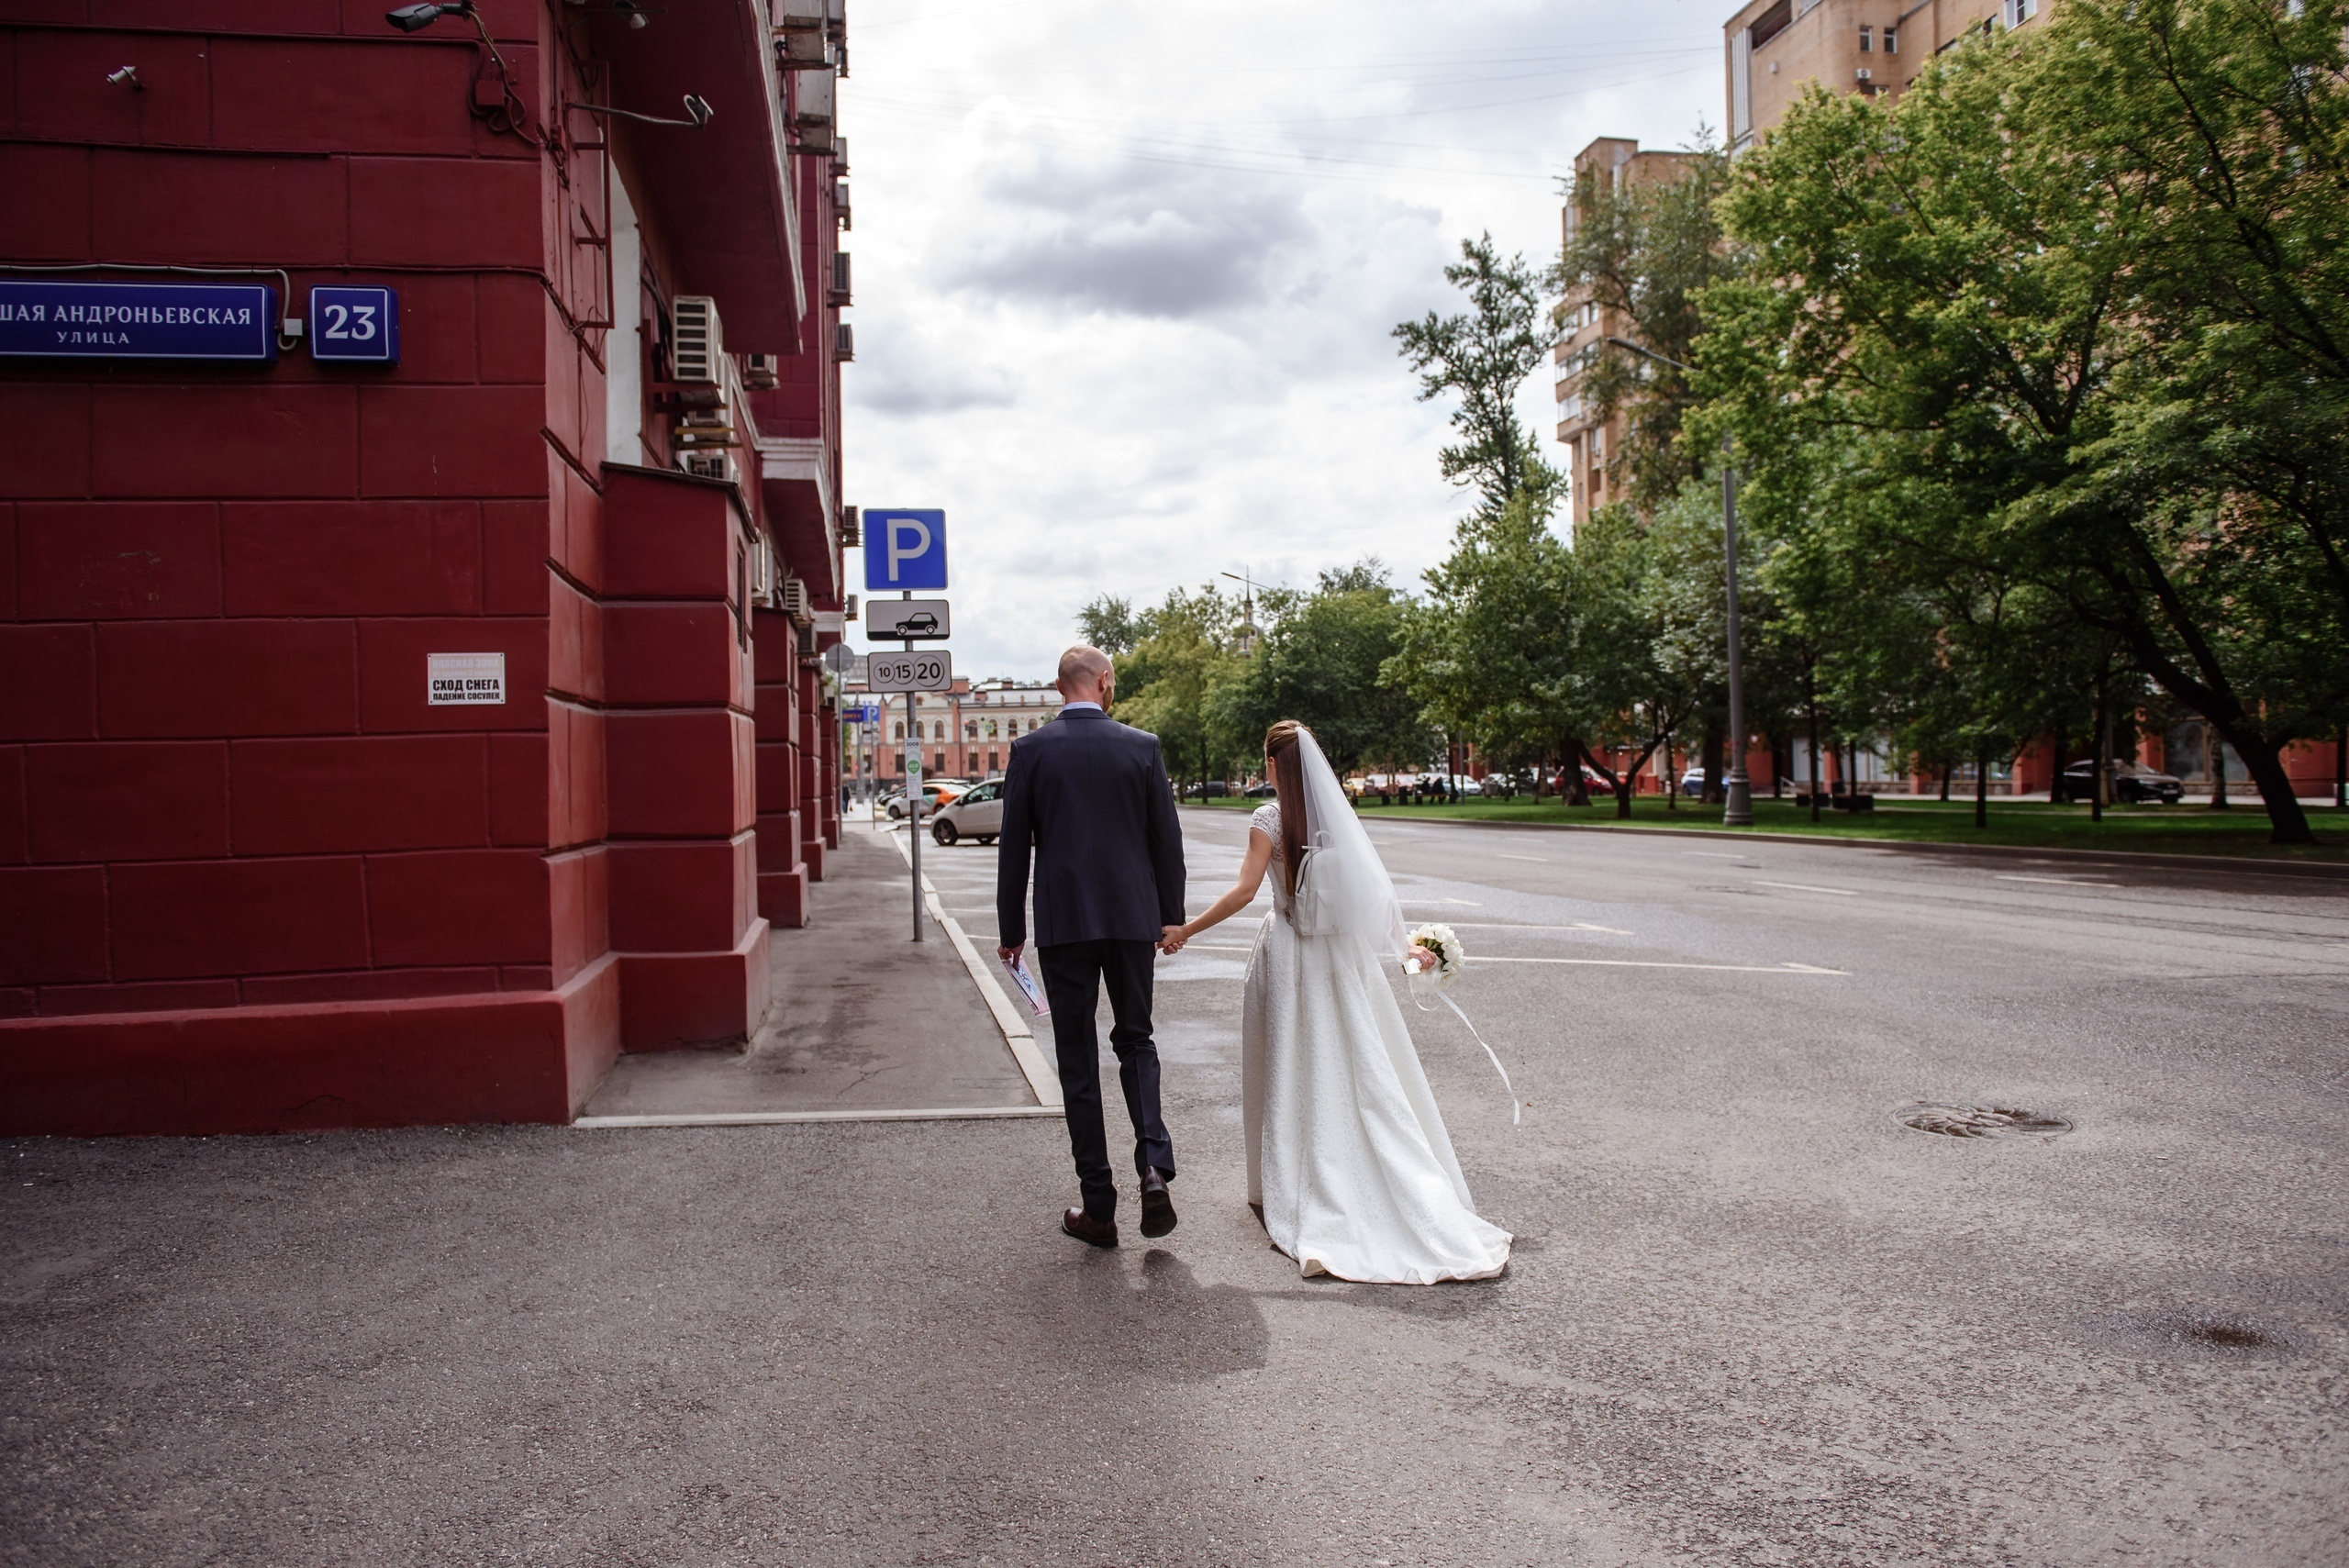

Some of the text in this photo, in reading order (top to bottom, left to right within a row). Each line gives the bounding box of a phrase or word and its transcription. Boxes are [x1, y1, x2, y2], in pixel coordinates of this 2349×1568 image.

[53, 306, 251, 325] АНДРОНЬЕВСКАЯ
[324, 304, 376, 340] 23
[56, 331, 130, 344] УЛИЦА
[886, 518, 931, 582] P
[432, 658, 500, 669] ОПАСНАЯ ЗОНА
[878, 662, 941, 680] 10 15 20
[432, 679, 500, 692] СХОД СНЕГА
[433, 692, 500, 701] ПАДЕНИЕ СОСУЛЕК
